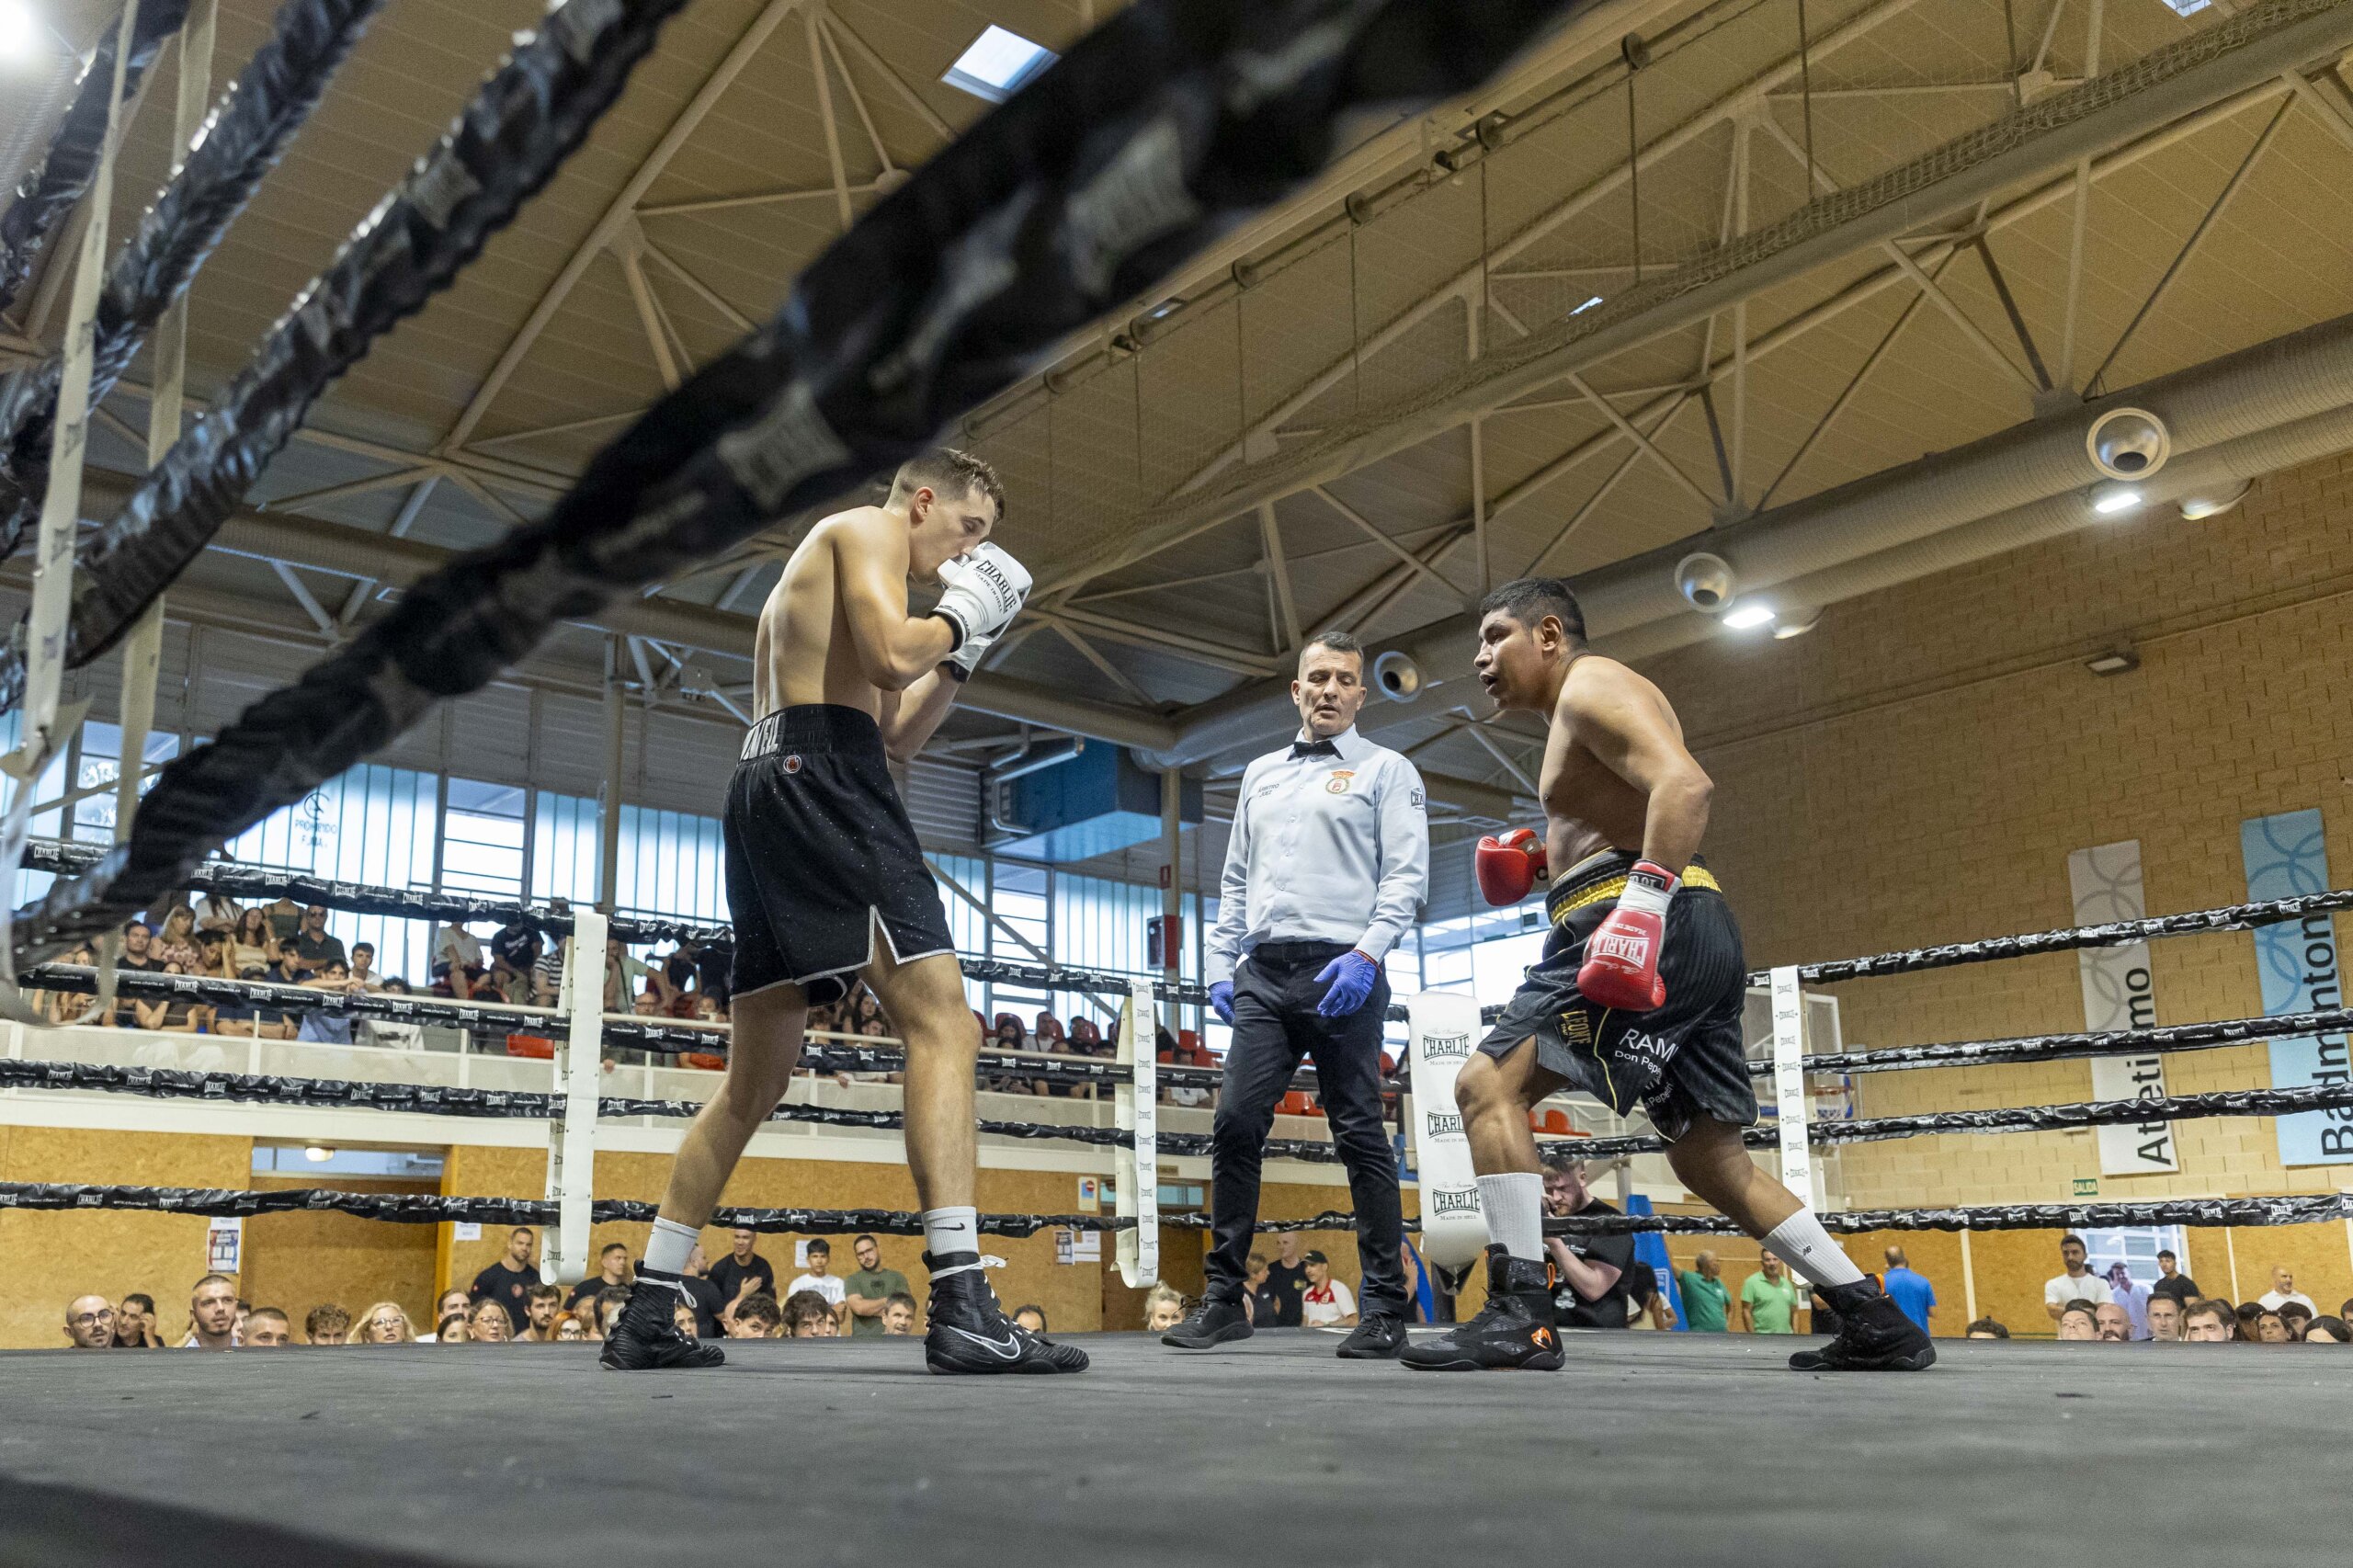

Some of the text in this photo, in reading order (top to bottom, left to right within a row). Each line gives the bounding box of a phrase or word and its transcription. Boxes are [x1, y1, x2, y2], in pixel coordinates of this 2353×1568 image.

[976, 559, 1017, 614] CHARLIE
[34, 846, 59, 861] CHARLIE
[1591, 931, 1649, 966] CHARLIE
[175, 980, 198, 994] CHARLIE
[249, 986, 272, 1002] CHARLIE
[322, 994, 344, 1008] CHARLIE
[1560, 1010, 1591, 1047] LEONE
[2301, 912, 2353, 1156] Bdmnton
[1423, 1035, 1470, 1059] CHARLIE
[1615, 1051, 1638, 1062] Don
[2125, 968, 2172, 1166] Atetimo
[77, 1193, 103, 1206] CHARLIE
[1433, 1189, 1480, 1213] CHARLIE
